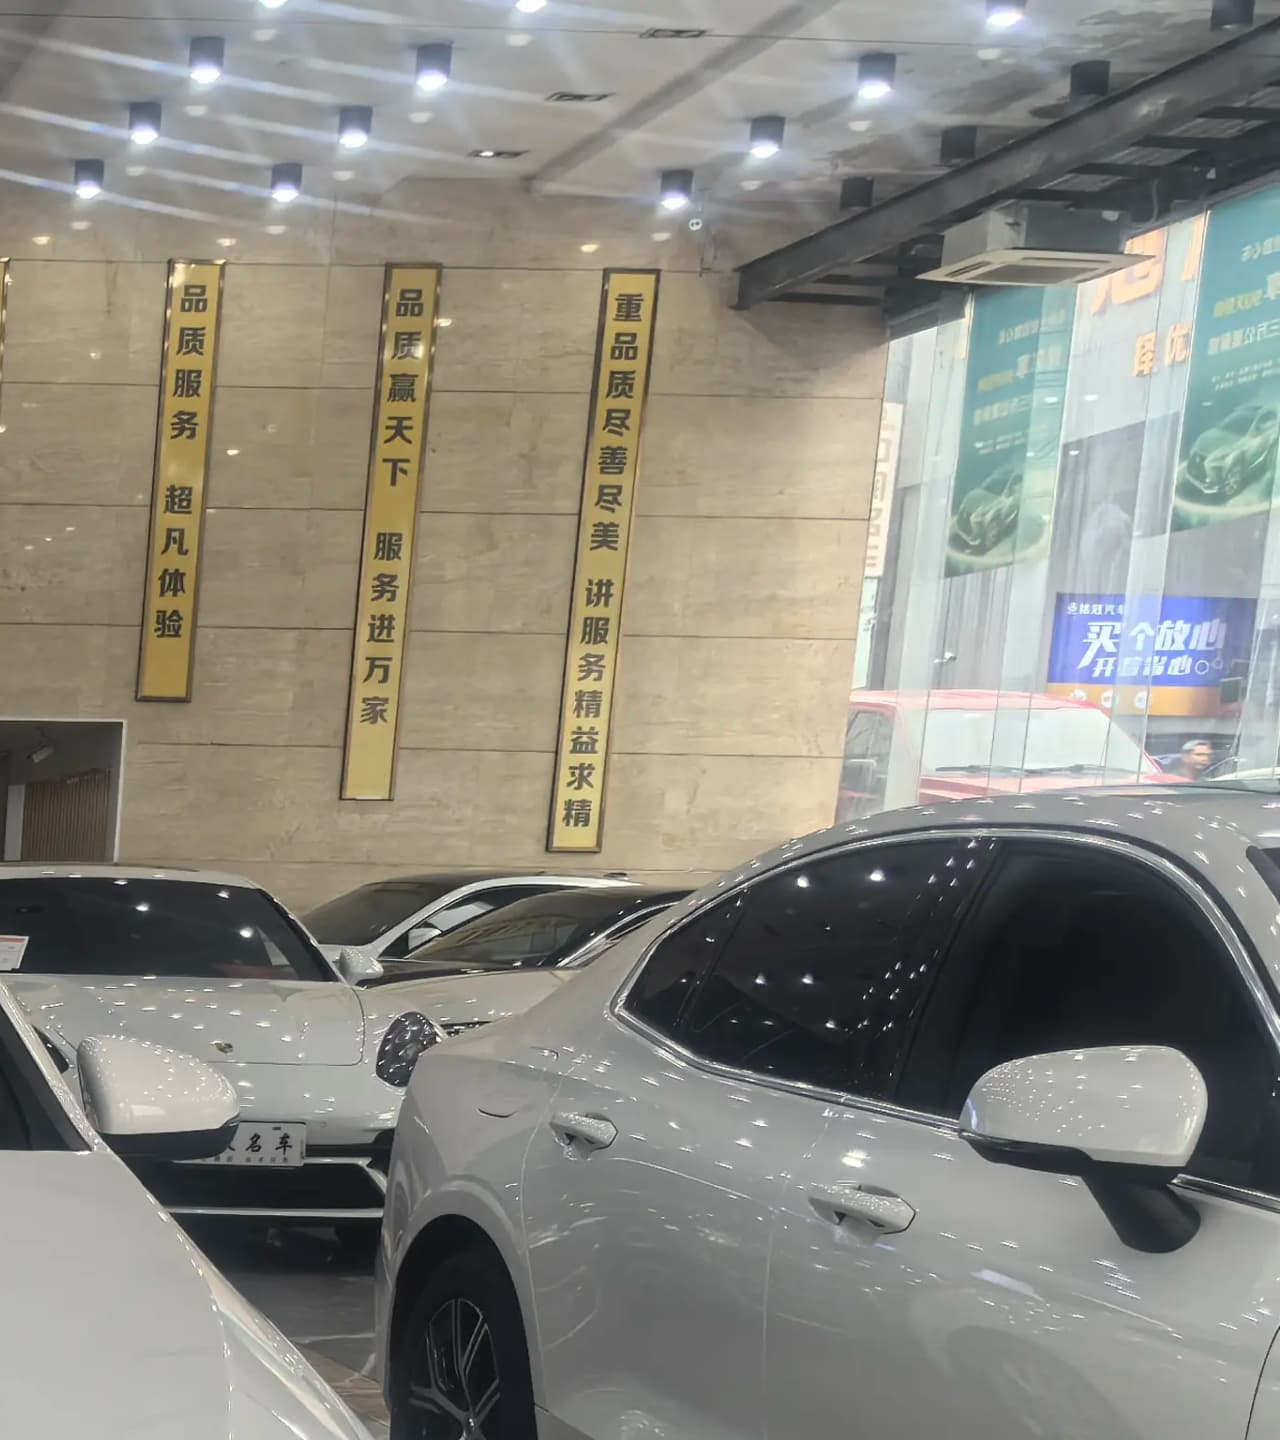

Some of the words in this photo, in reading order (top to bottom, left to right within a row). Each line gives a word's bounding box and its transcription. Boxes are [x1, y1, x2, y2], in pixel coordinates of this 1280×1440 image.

[170, 284, 208, 440] 品质服务
[382, 289, 424, 486] 品质赢天下
[589, 293, 644, 552] 重品质尽善尽美
[154, 484, 192, 638] 超凡体验
[360, 532, 402, 725] 服务进万家
[562, 578, 613, 828] 讲服务精益求精
